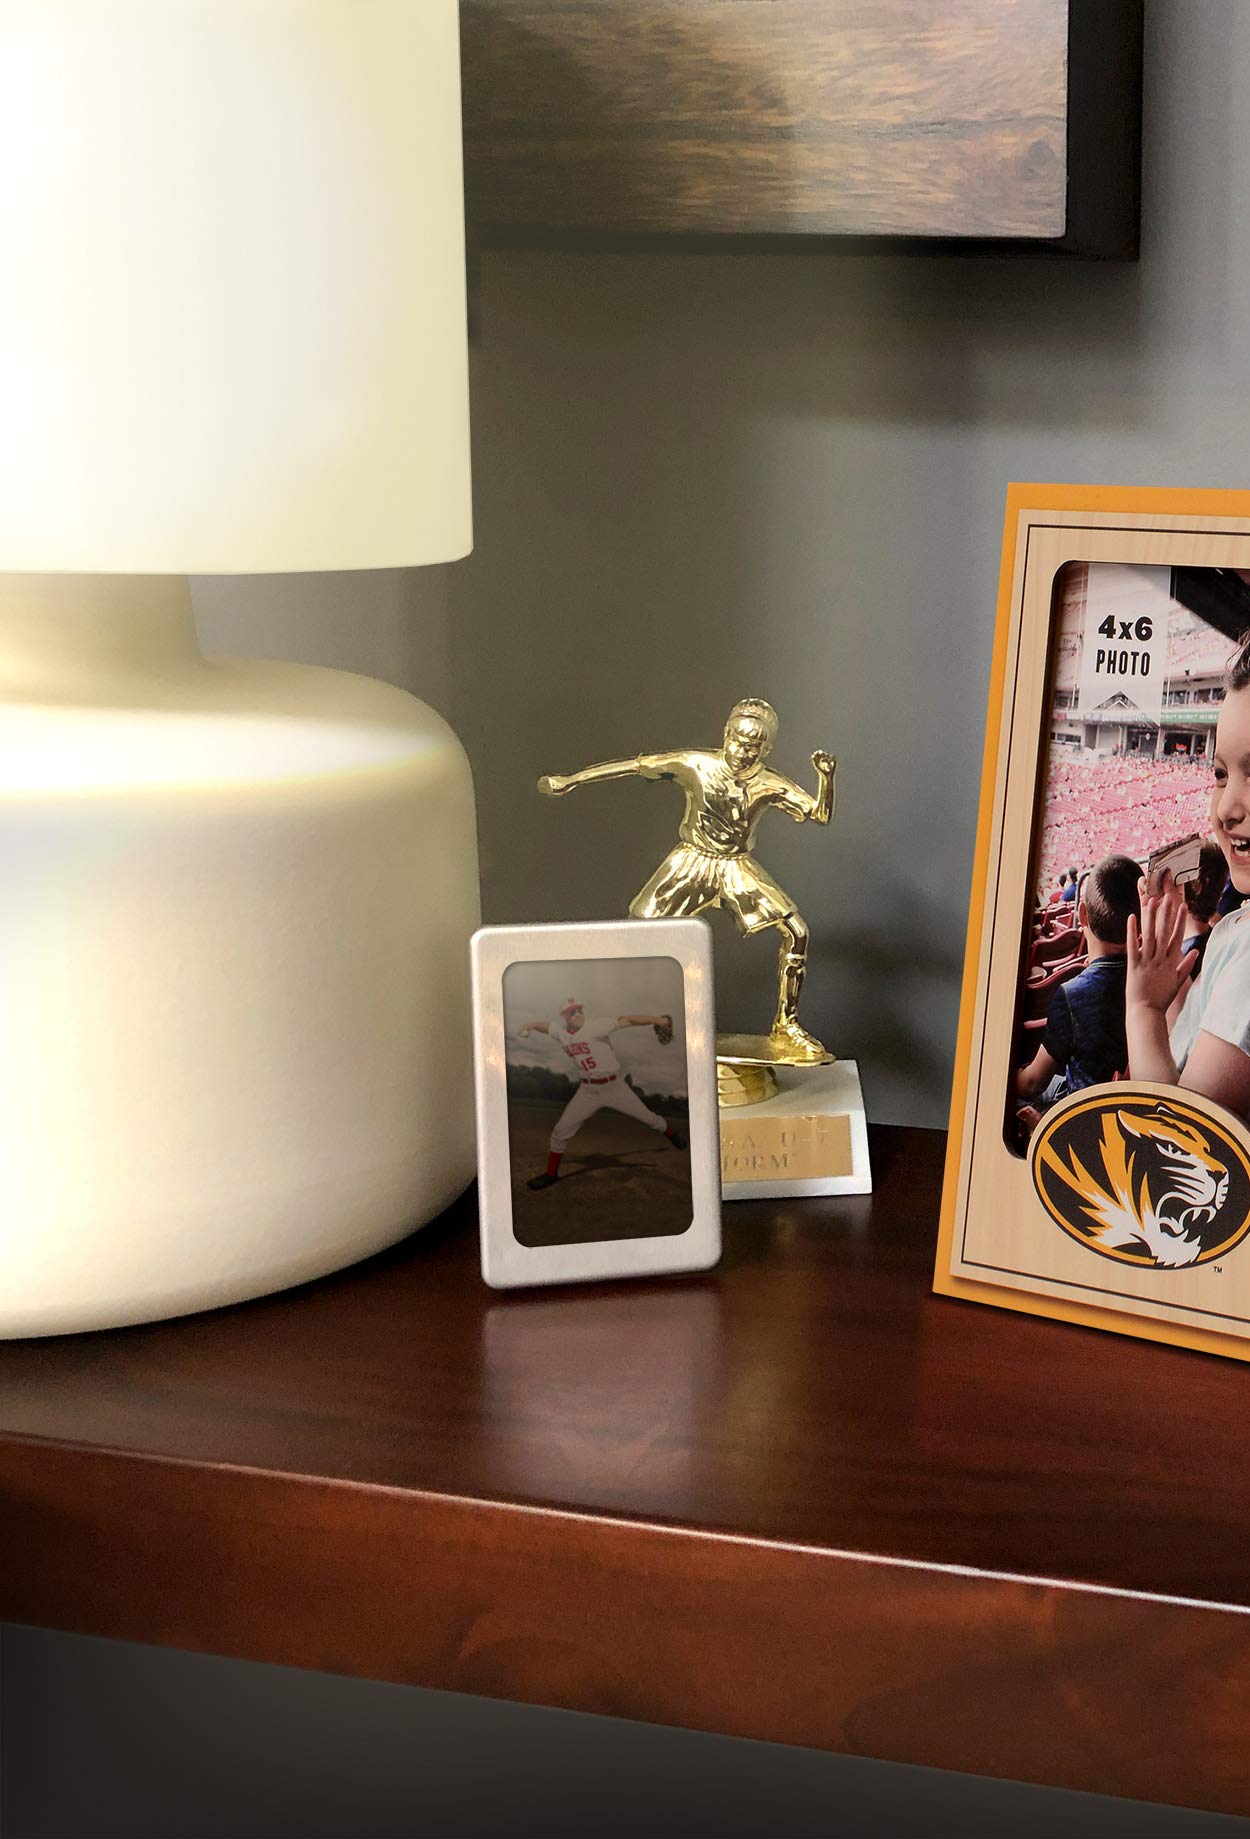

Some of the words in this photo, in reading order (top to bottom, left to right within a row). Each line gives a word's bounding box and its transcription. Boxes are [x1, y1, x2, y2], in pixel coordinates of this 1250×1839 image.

[1098, 614, 1153, 642] 4x6
[1095, 649, 1151, 677] PHOTO
[580, 1056, 597, 1073] 15
